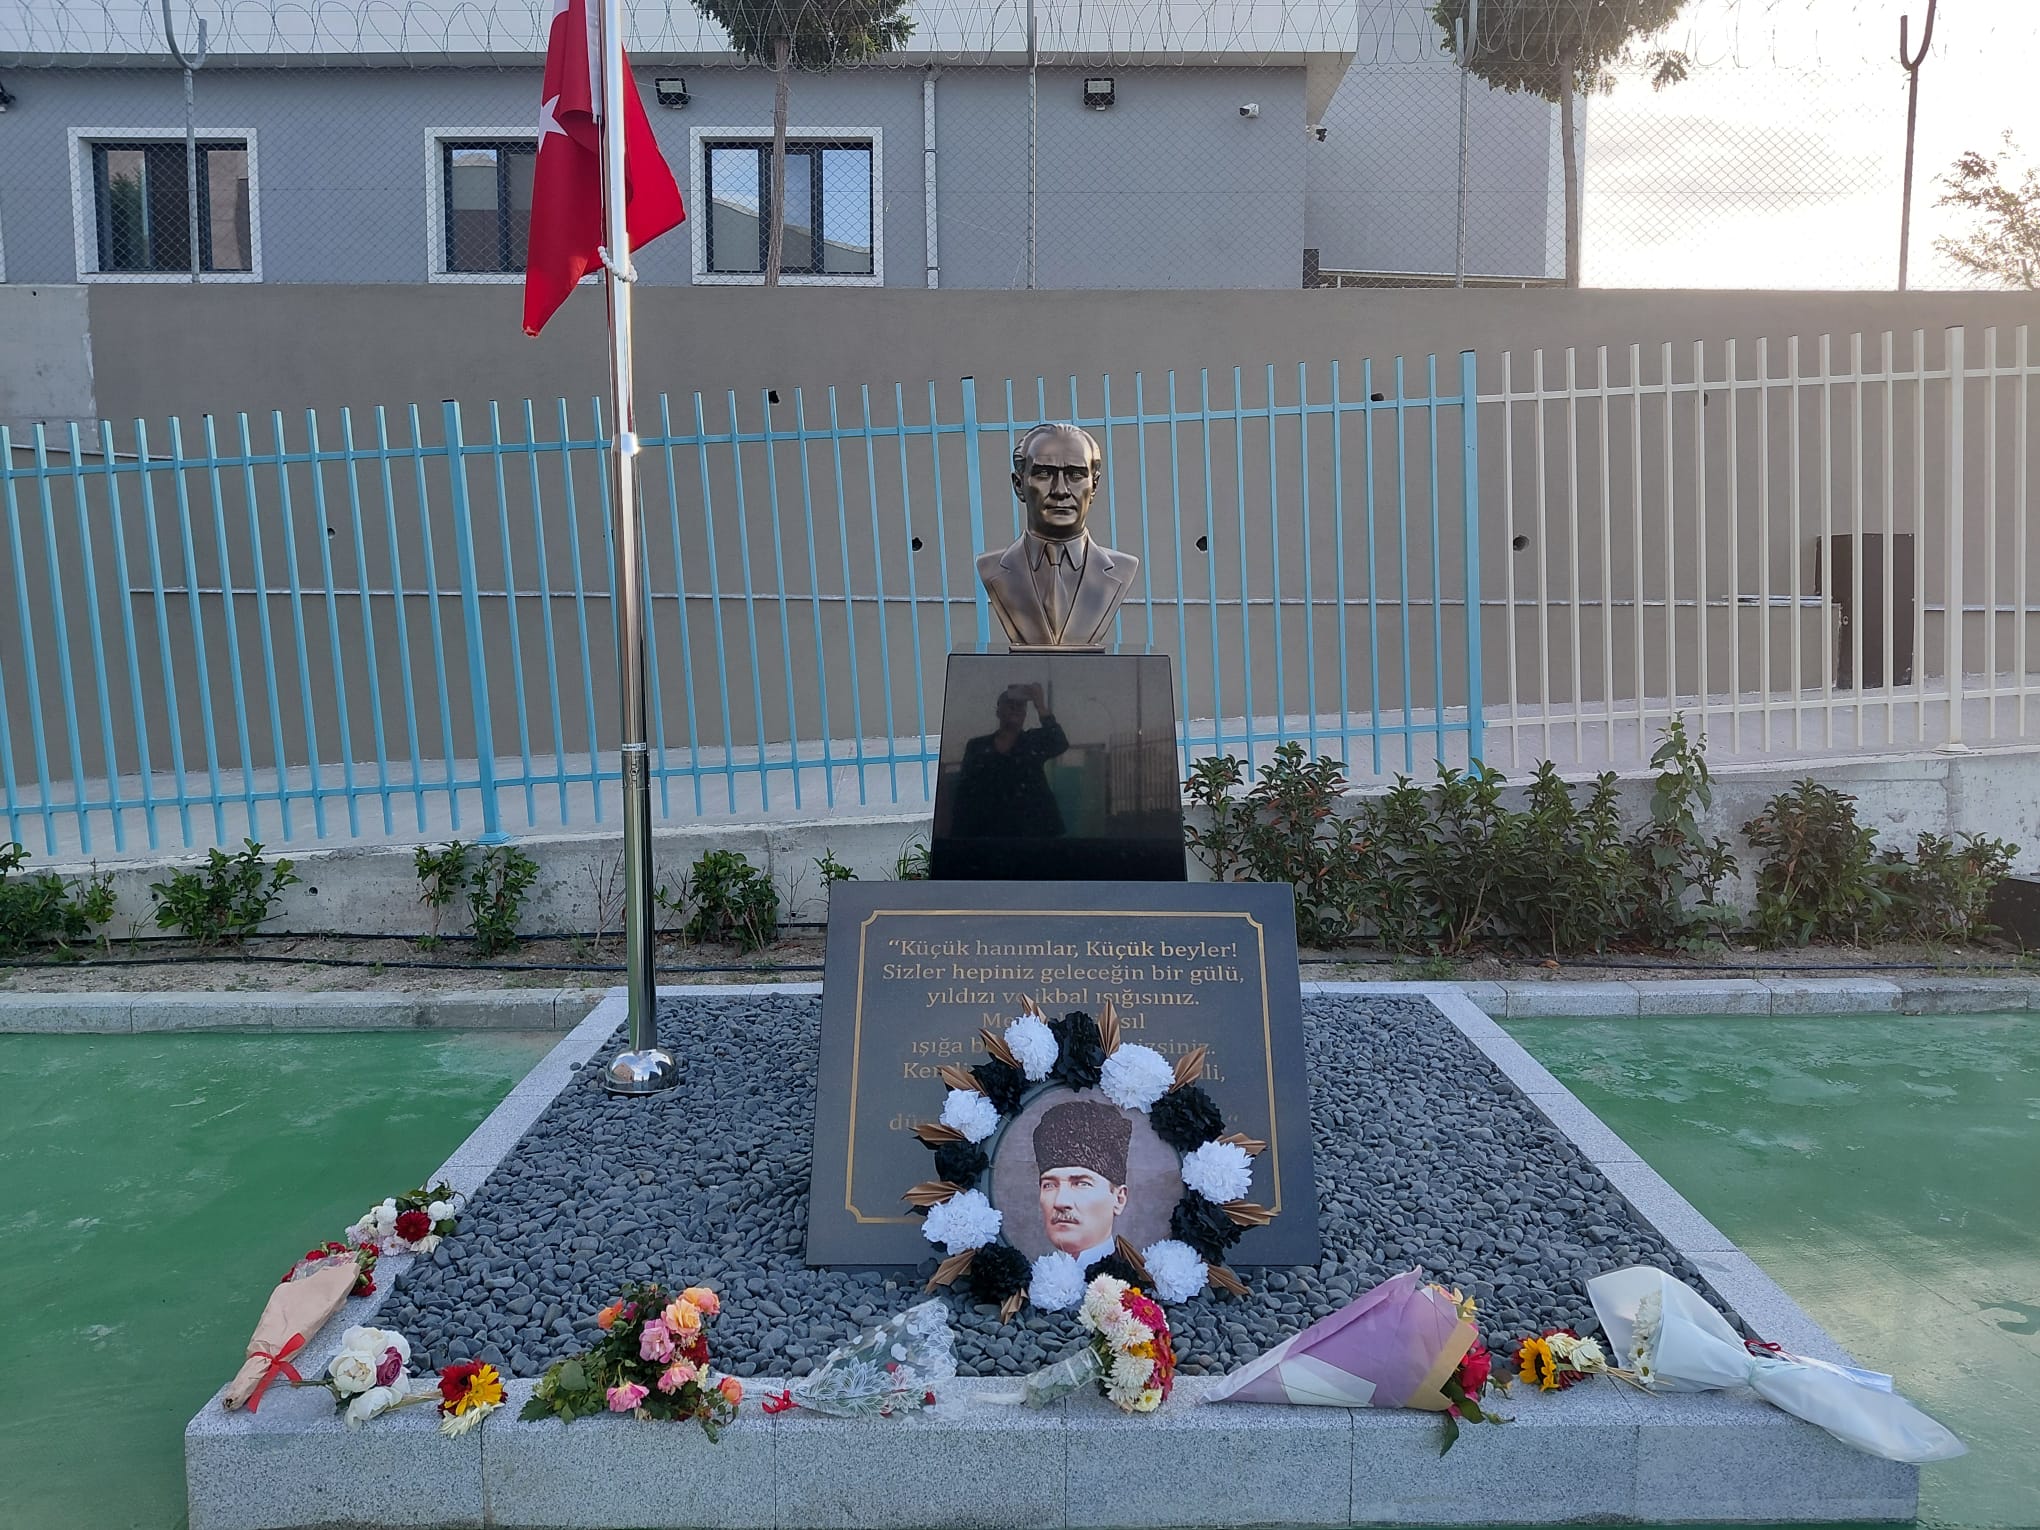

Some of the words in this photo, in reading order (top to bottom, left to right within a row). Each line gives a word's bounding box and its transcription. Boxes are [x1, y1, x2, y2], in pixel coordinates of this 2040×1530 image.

[976, 940, 1079, 960] hanımlar,
[1086, 940, 1155, 960] Küçük
[1160, 941, 1237, 961] beyler!
[882, 964, 946, 980] Sizler
[952, 964, 1034, 983] hepiniz
[1040, 964, 1144, 985] geleceğin
[1152, 965, 1184, 981] bir
[1190, 966, 1245, 986] gülü,
[926, 988, 995, 1008] yıldızı
[1035, 988, 1088, 1004] ikbal
[911, 1037, 962, 1058] ışığa
